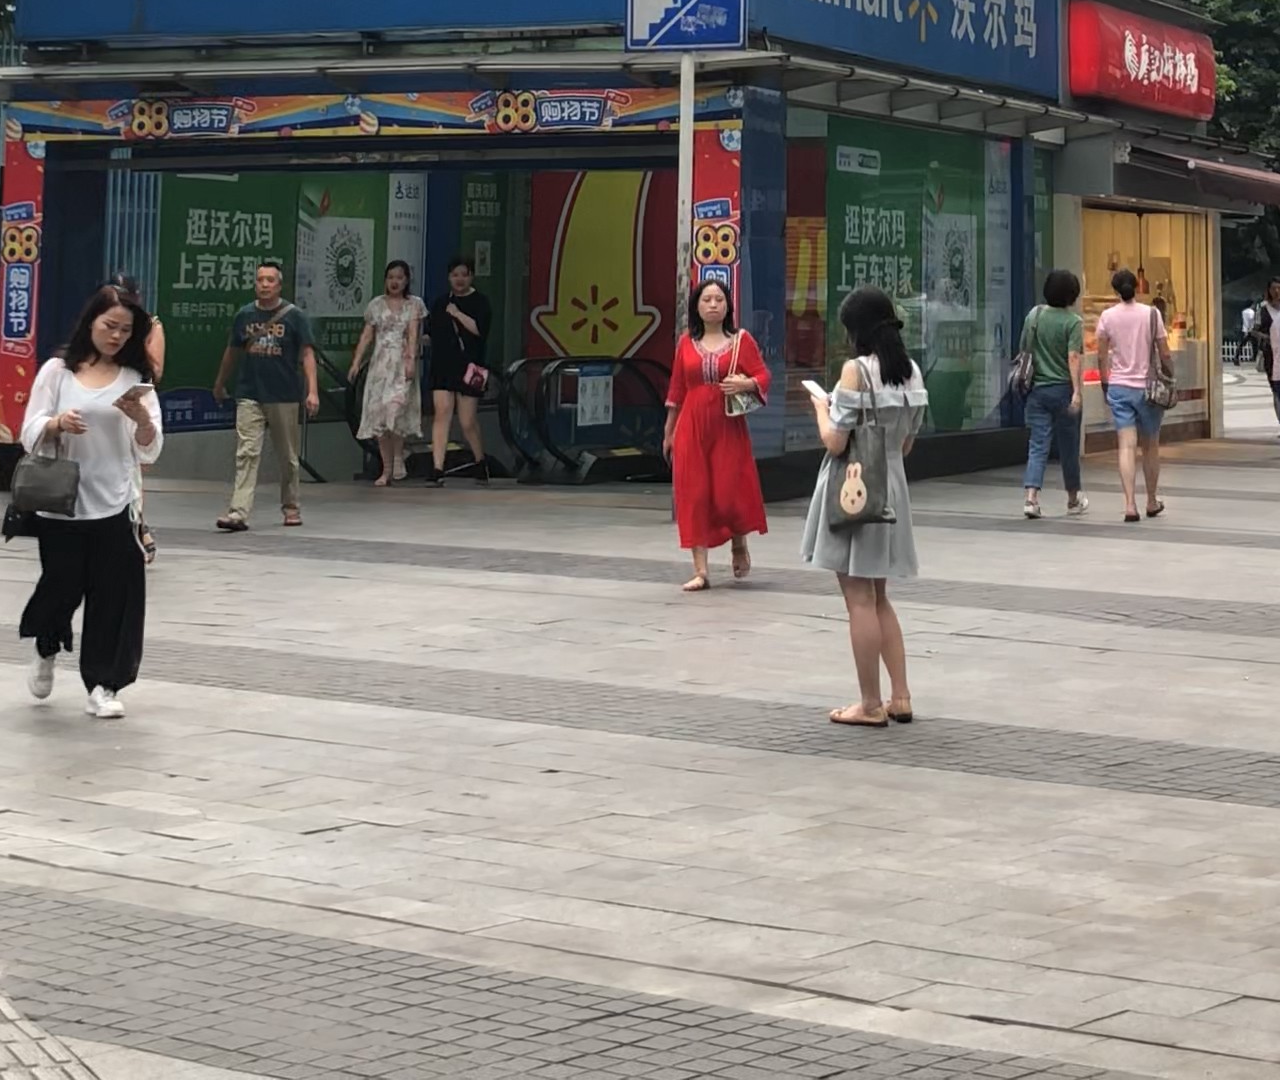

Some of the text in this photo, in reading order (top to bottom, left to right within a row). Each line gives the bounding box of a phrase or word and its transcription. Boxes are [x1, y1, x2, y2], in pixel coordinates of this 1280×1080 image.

[132, 100, 169, 137] 88
[173, 108, 228, 130] 购物节
[495, 91, 537, 132] 88
[541, 100, 600, 123] 购物节
[1, 225, 40, 263] 88
[186, 208, 273, 249] 逛沃尔玛
[695, 224, 738, 265] 88
[844, 204, 906, 249] 逛沃尔玛
[172, 252, 283, 292] 上京东到
[837, 251, 913, 295] 上京东到家
[8, 267, 30, 333] 购物节
